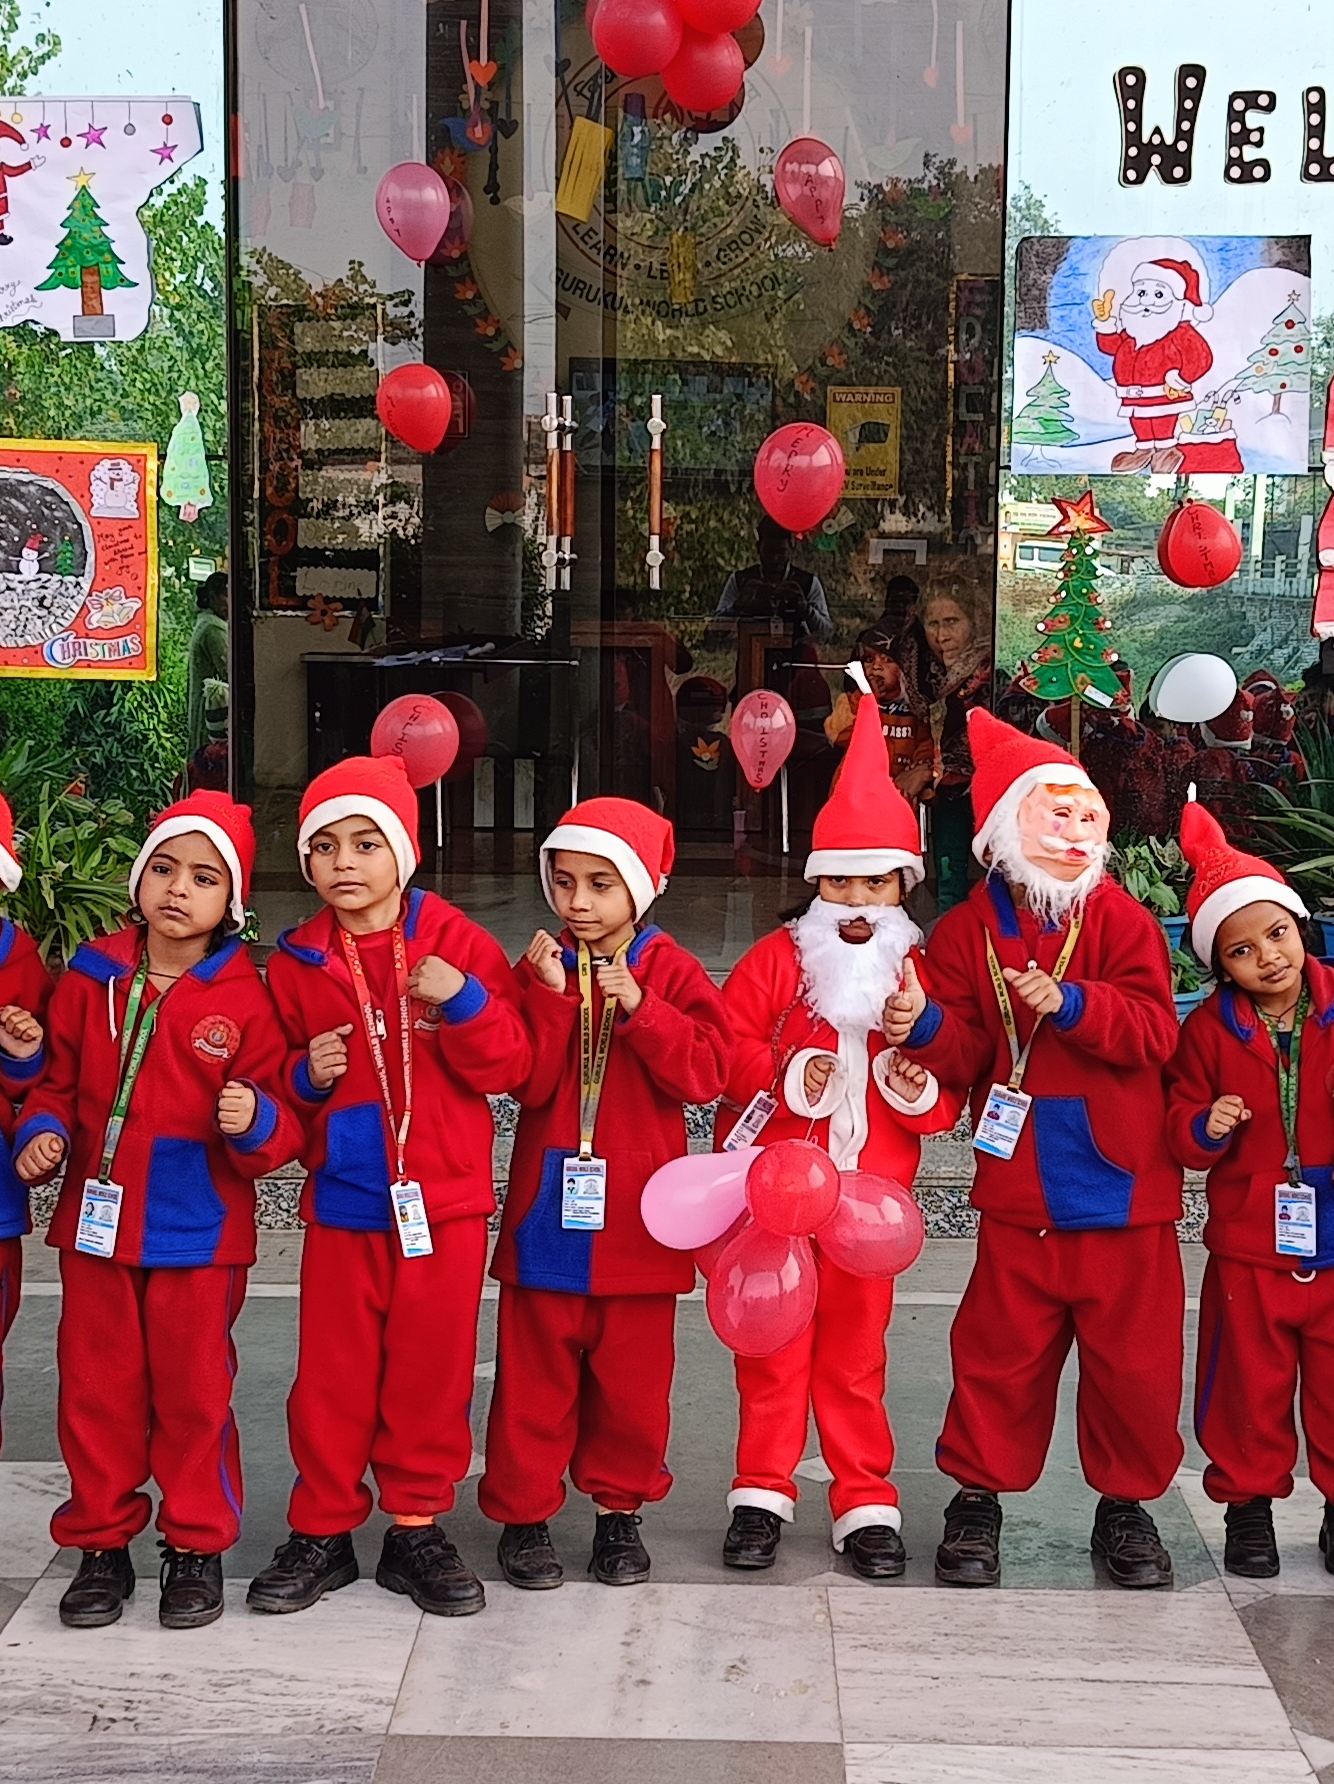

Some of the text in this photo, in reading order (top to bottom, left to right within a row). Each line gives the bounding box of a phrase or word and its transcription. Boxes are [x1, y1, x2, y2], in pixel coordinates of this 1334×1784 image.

[571, 222, 630, 271] LEARN
[639, 298, 708, 319] WORLD
[713, 271, 789, 313] SCHOOL
[835, 392, 894, 403] WARNING
[865, 467, 887, 477] Under
[45, 632, 141, 666] CHRISTMAS
[399, 995, 409, 1030] SCHOOL
